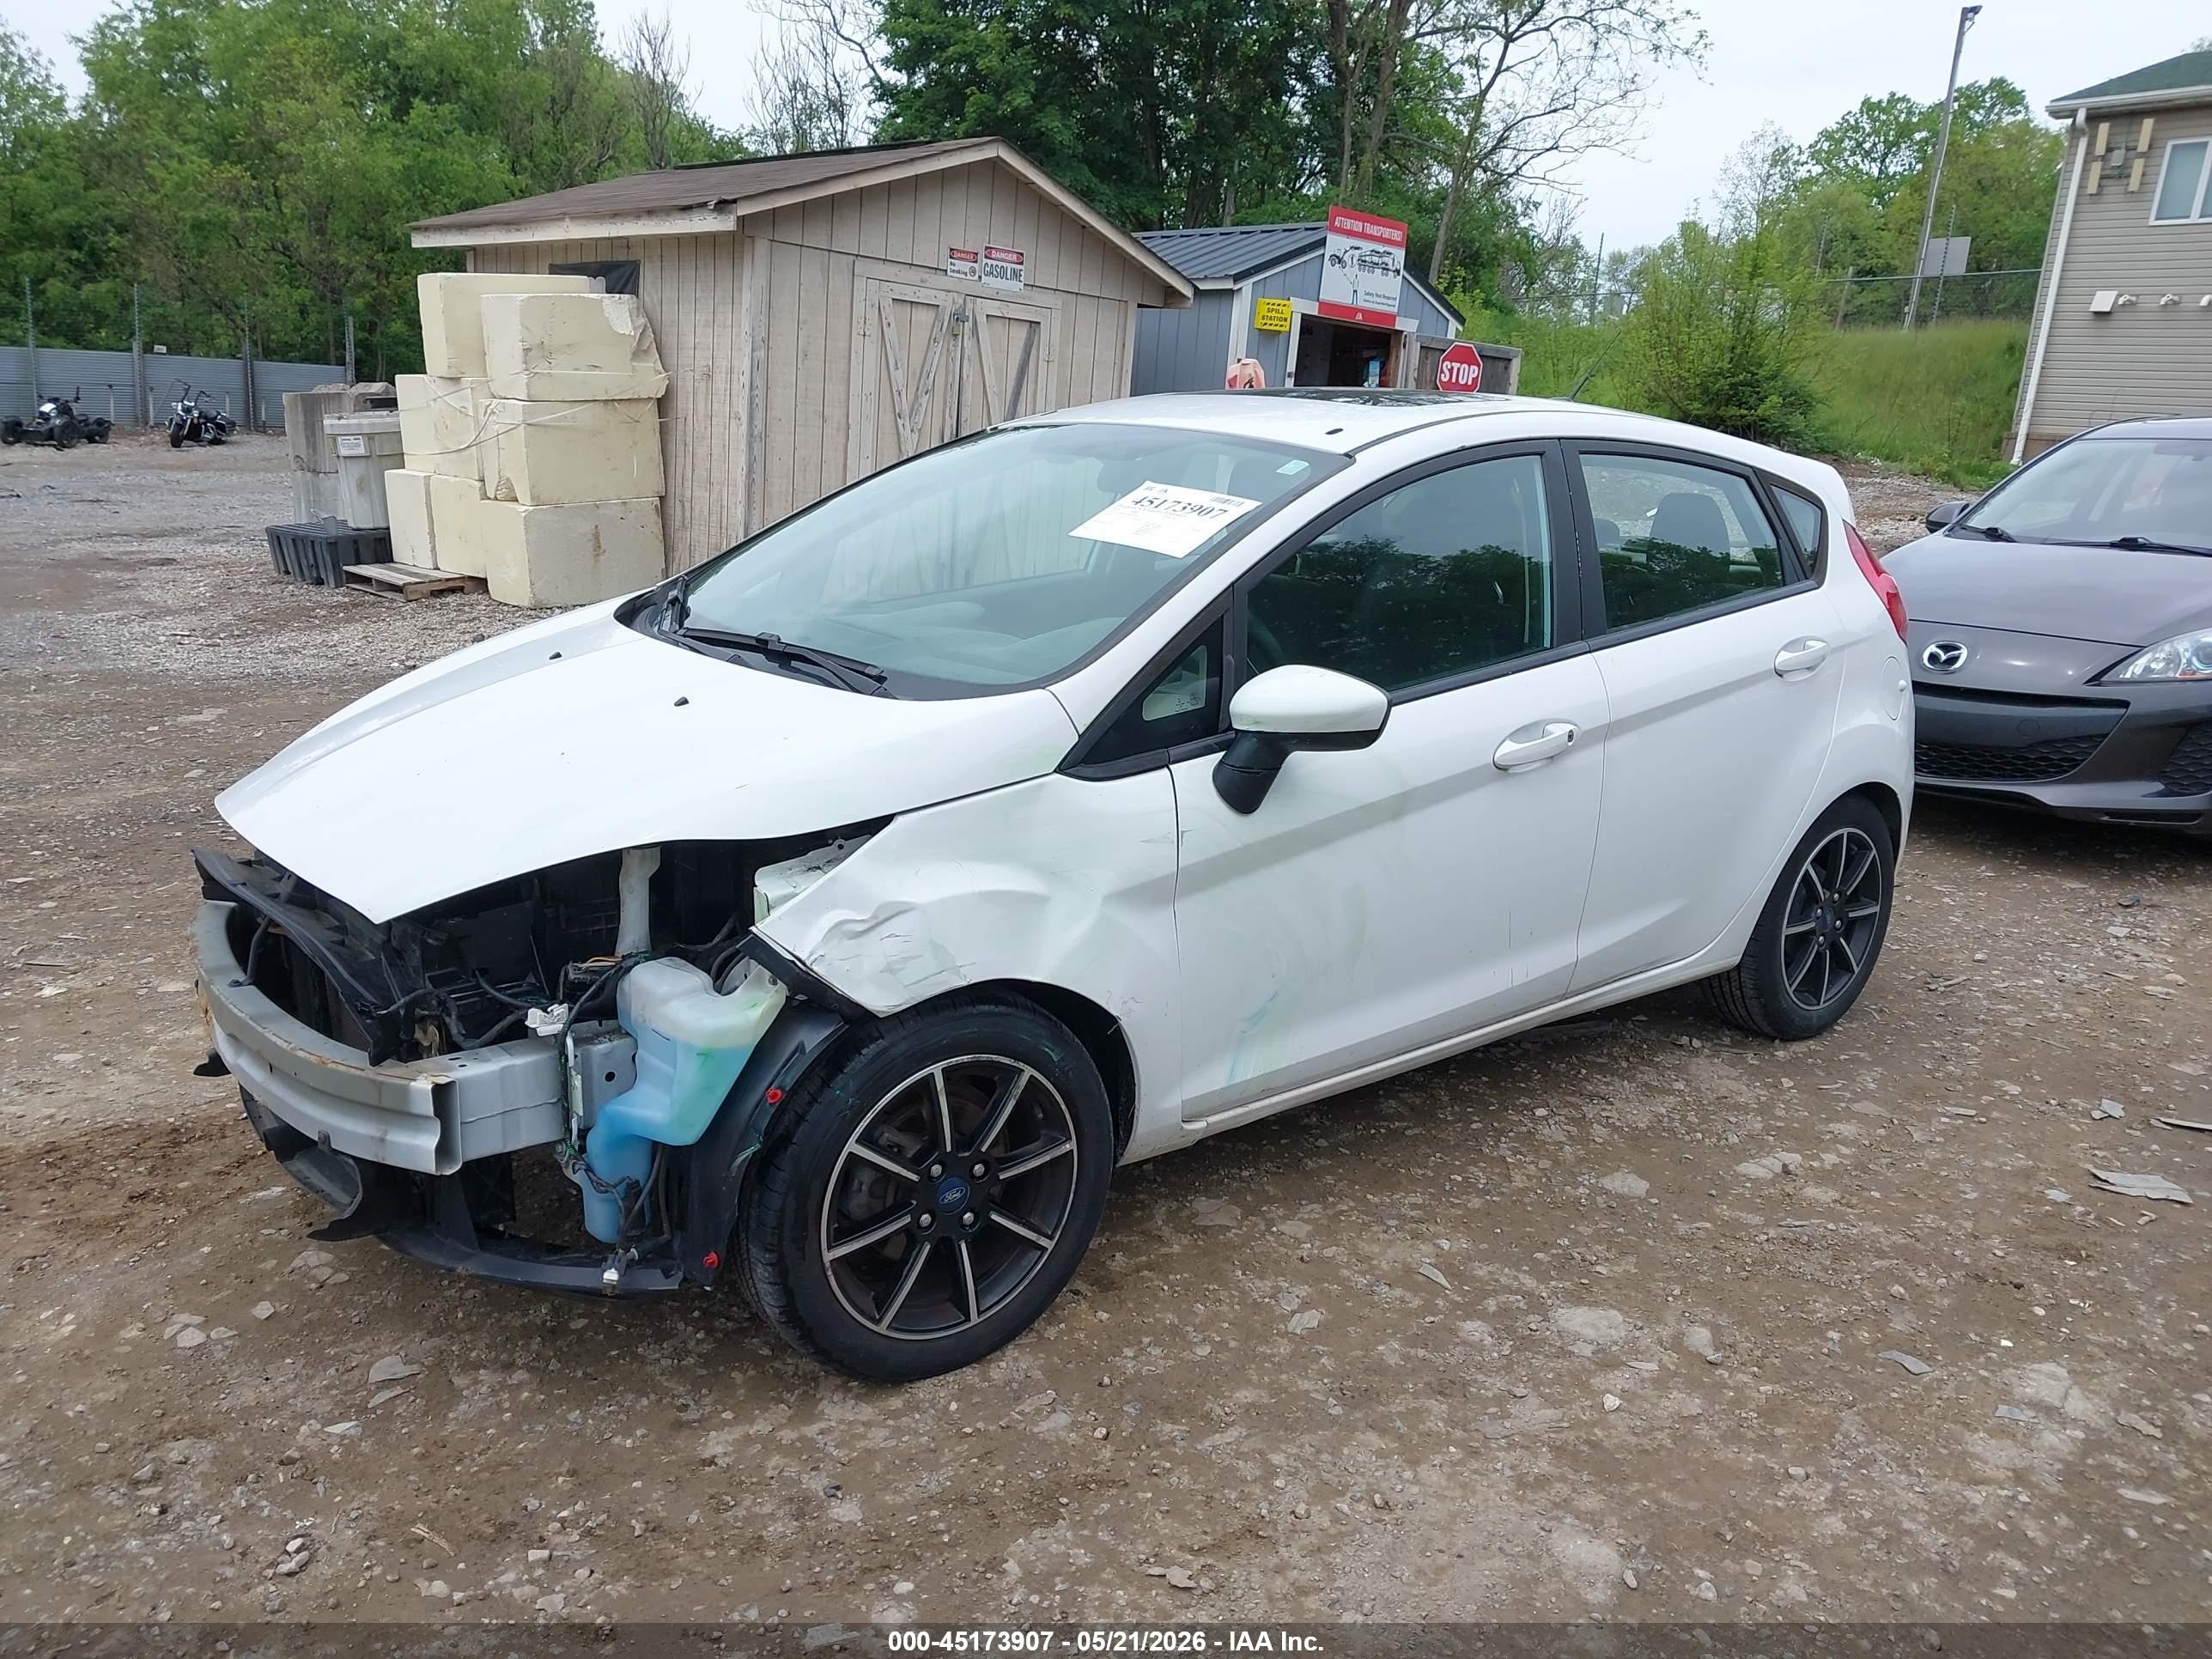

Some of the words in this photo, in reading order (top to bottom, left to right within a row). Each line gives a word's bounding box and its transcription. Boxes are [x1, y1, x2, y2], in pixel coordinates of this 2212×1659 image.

[1334, 216, 1363, 233] ATTENTION
[1364, 222, 1403, 241] TRANSPORTERS!
[953, 250, 974, 259] DANGER
[992, 251, 1017, 261] DANGER
[983, 262, 1024, 283] GASOLINE
[1441, 361, 1479, 386] STOP
[1132, 495, 1229, 519] 45173907
